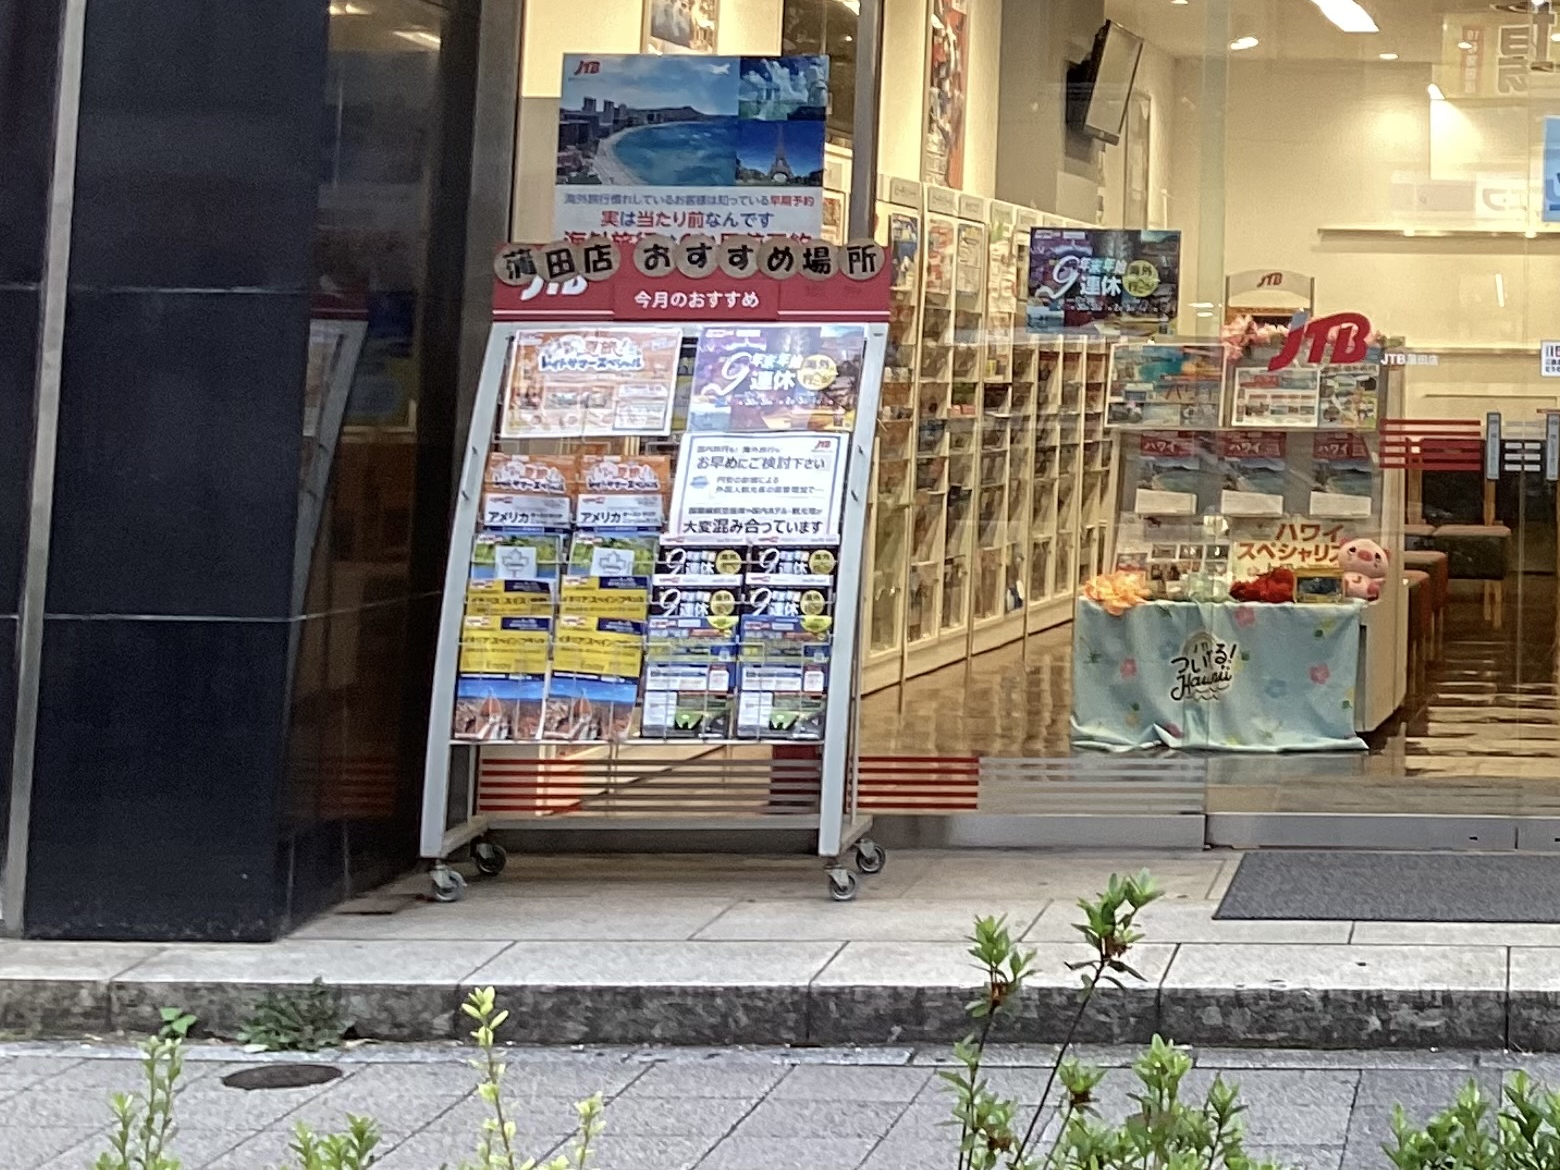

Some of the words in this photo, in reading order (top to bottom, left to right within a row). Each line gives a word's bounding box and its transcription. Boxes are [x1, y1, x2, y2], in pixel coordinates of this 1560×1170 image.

[574, 59, 601, 76] JTB
[601, 211, 774, 228] 実は当たり前なんです
[503, 244, 612, 279] 蒲田店
[644, 244, 876, 275] おすすめ場所
[1257, 272, 1283, 288] JTB
[634, 291, 760, 308] 今月のおすすめ
[1268, 312, 1371, 371] JTB
[1144, 442, 1178, 453] ハワイ
[697, 456, 825, 470] お早めにご検討下さい
[488, 511, 529, 524] アメリカ
[581, 511, 621, 524] アメリカ
[683, 518, 824, 534] 大変混み合っています
[1275, 524, 1344, 542] ハワイ
